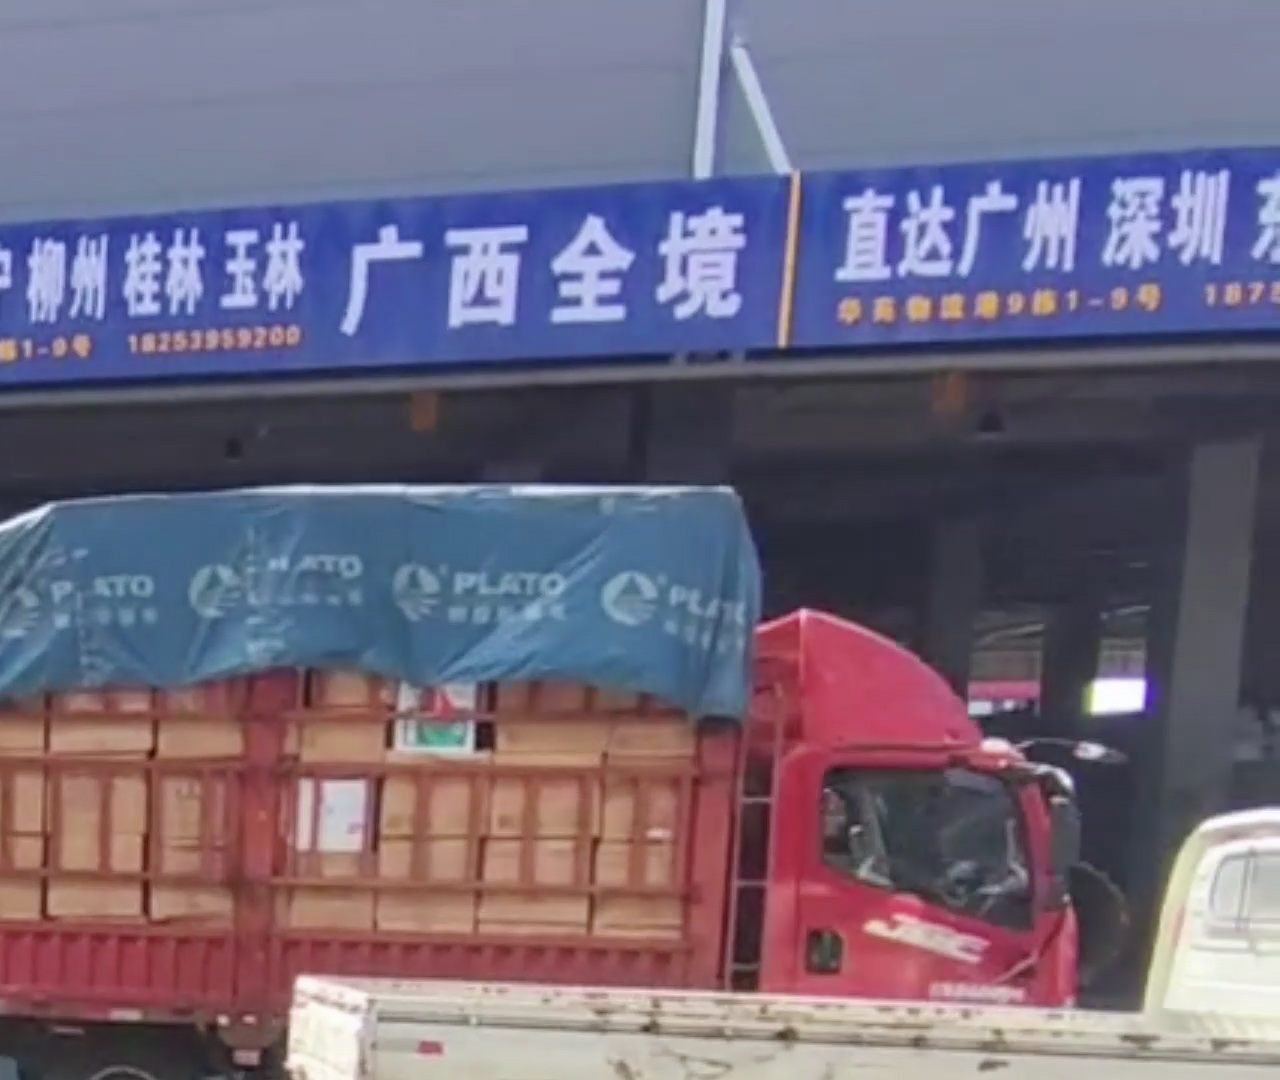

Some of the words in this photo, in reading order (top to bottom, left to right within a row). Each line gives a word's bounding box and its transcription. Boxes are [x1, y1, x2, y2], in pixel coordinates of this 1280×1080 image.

[27, 236, 107, 322] 柳州
[124, 229, 204, 315] 桂林
[221, 223, 304, 309] 玉林
[341, 207, 745, 335] 广西全境
[835, 179, 1080, 281] 直达广州
[1102, 170, 1229, 269] 深圳
[453, 570, 567, 598] PLATO
